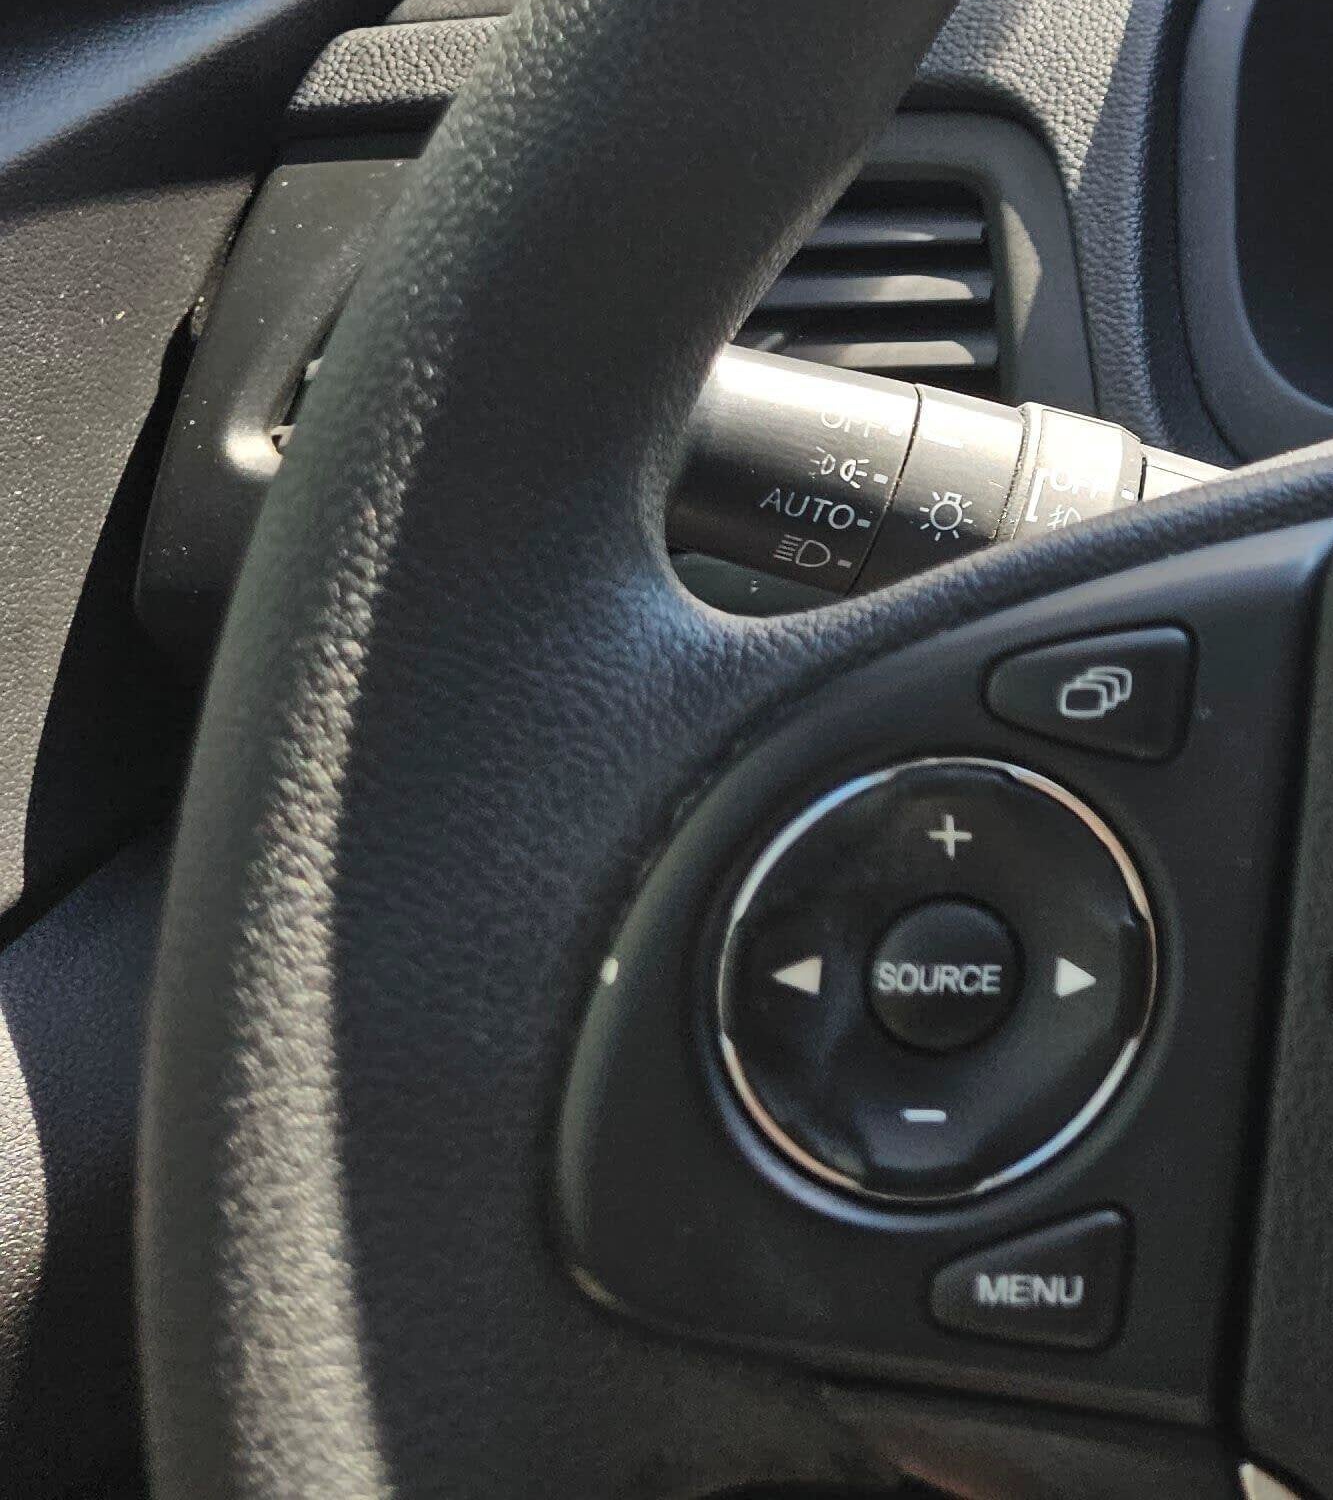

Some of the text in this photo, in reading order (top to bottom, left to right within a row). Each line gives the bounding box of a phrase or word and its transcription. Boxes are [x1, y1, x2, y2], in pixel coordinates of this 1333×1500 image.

[760, 488, 856, 531] AUTO
[874, 960, 1002, 994] SOURCE
[976, 1273, 1085, 1307] MENU
